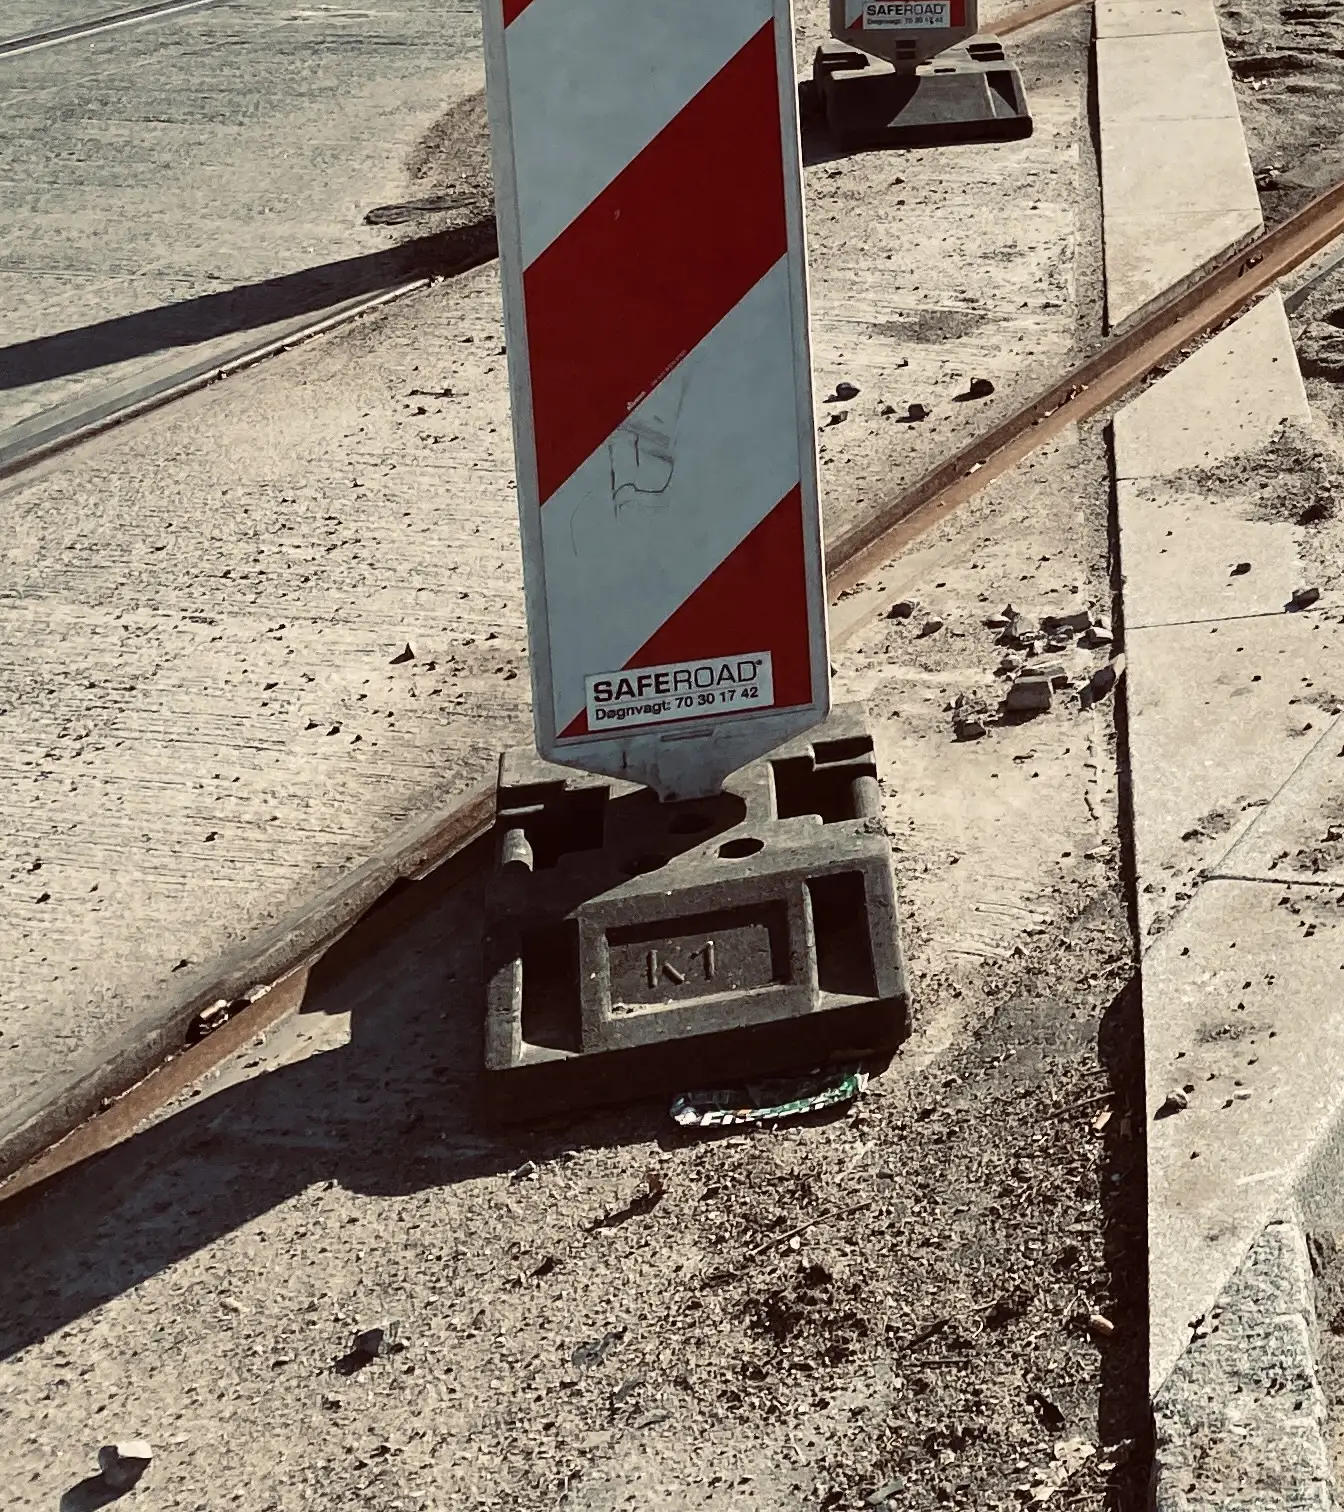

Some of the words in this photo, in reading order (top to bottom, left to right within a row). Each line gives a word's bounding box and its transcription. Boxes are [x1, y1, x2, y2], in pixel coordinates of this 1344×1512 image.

[866, 3, 945, 16] SAFEROAD
[595, 699, 671, 720] Døgnvagt:
[675, 696, 693, 709] 70
[697, 691, 716, 706] 30
[720, 689, 736, 703] 17
[741, 685, 759, 699] 42
